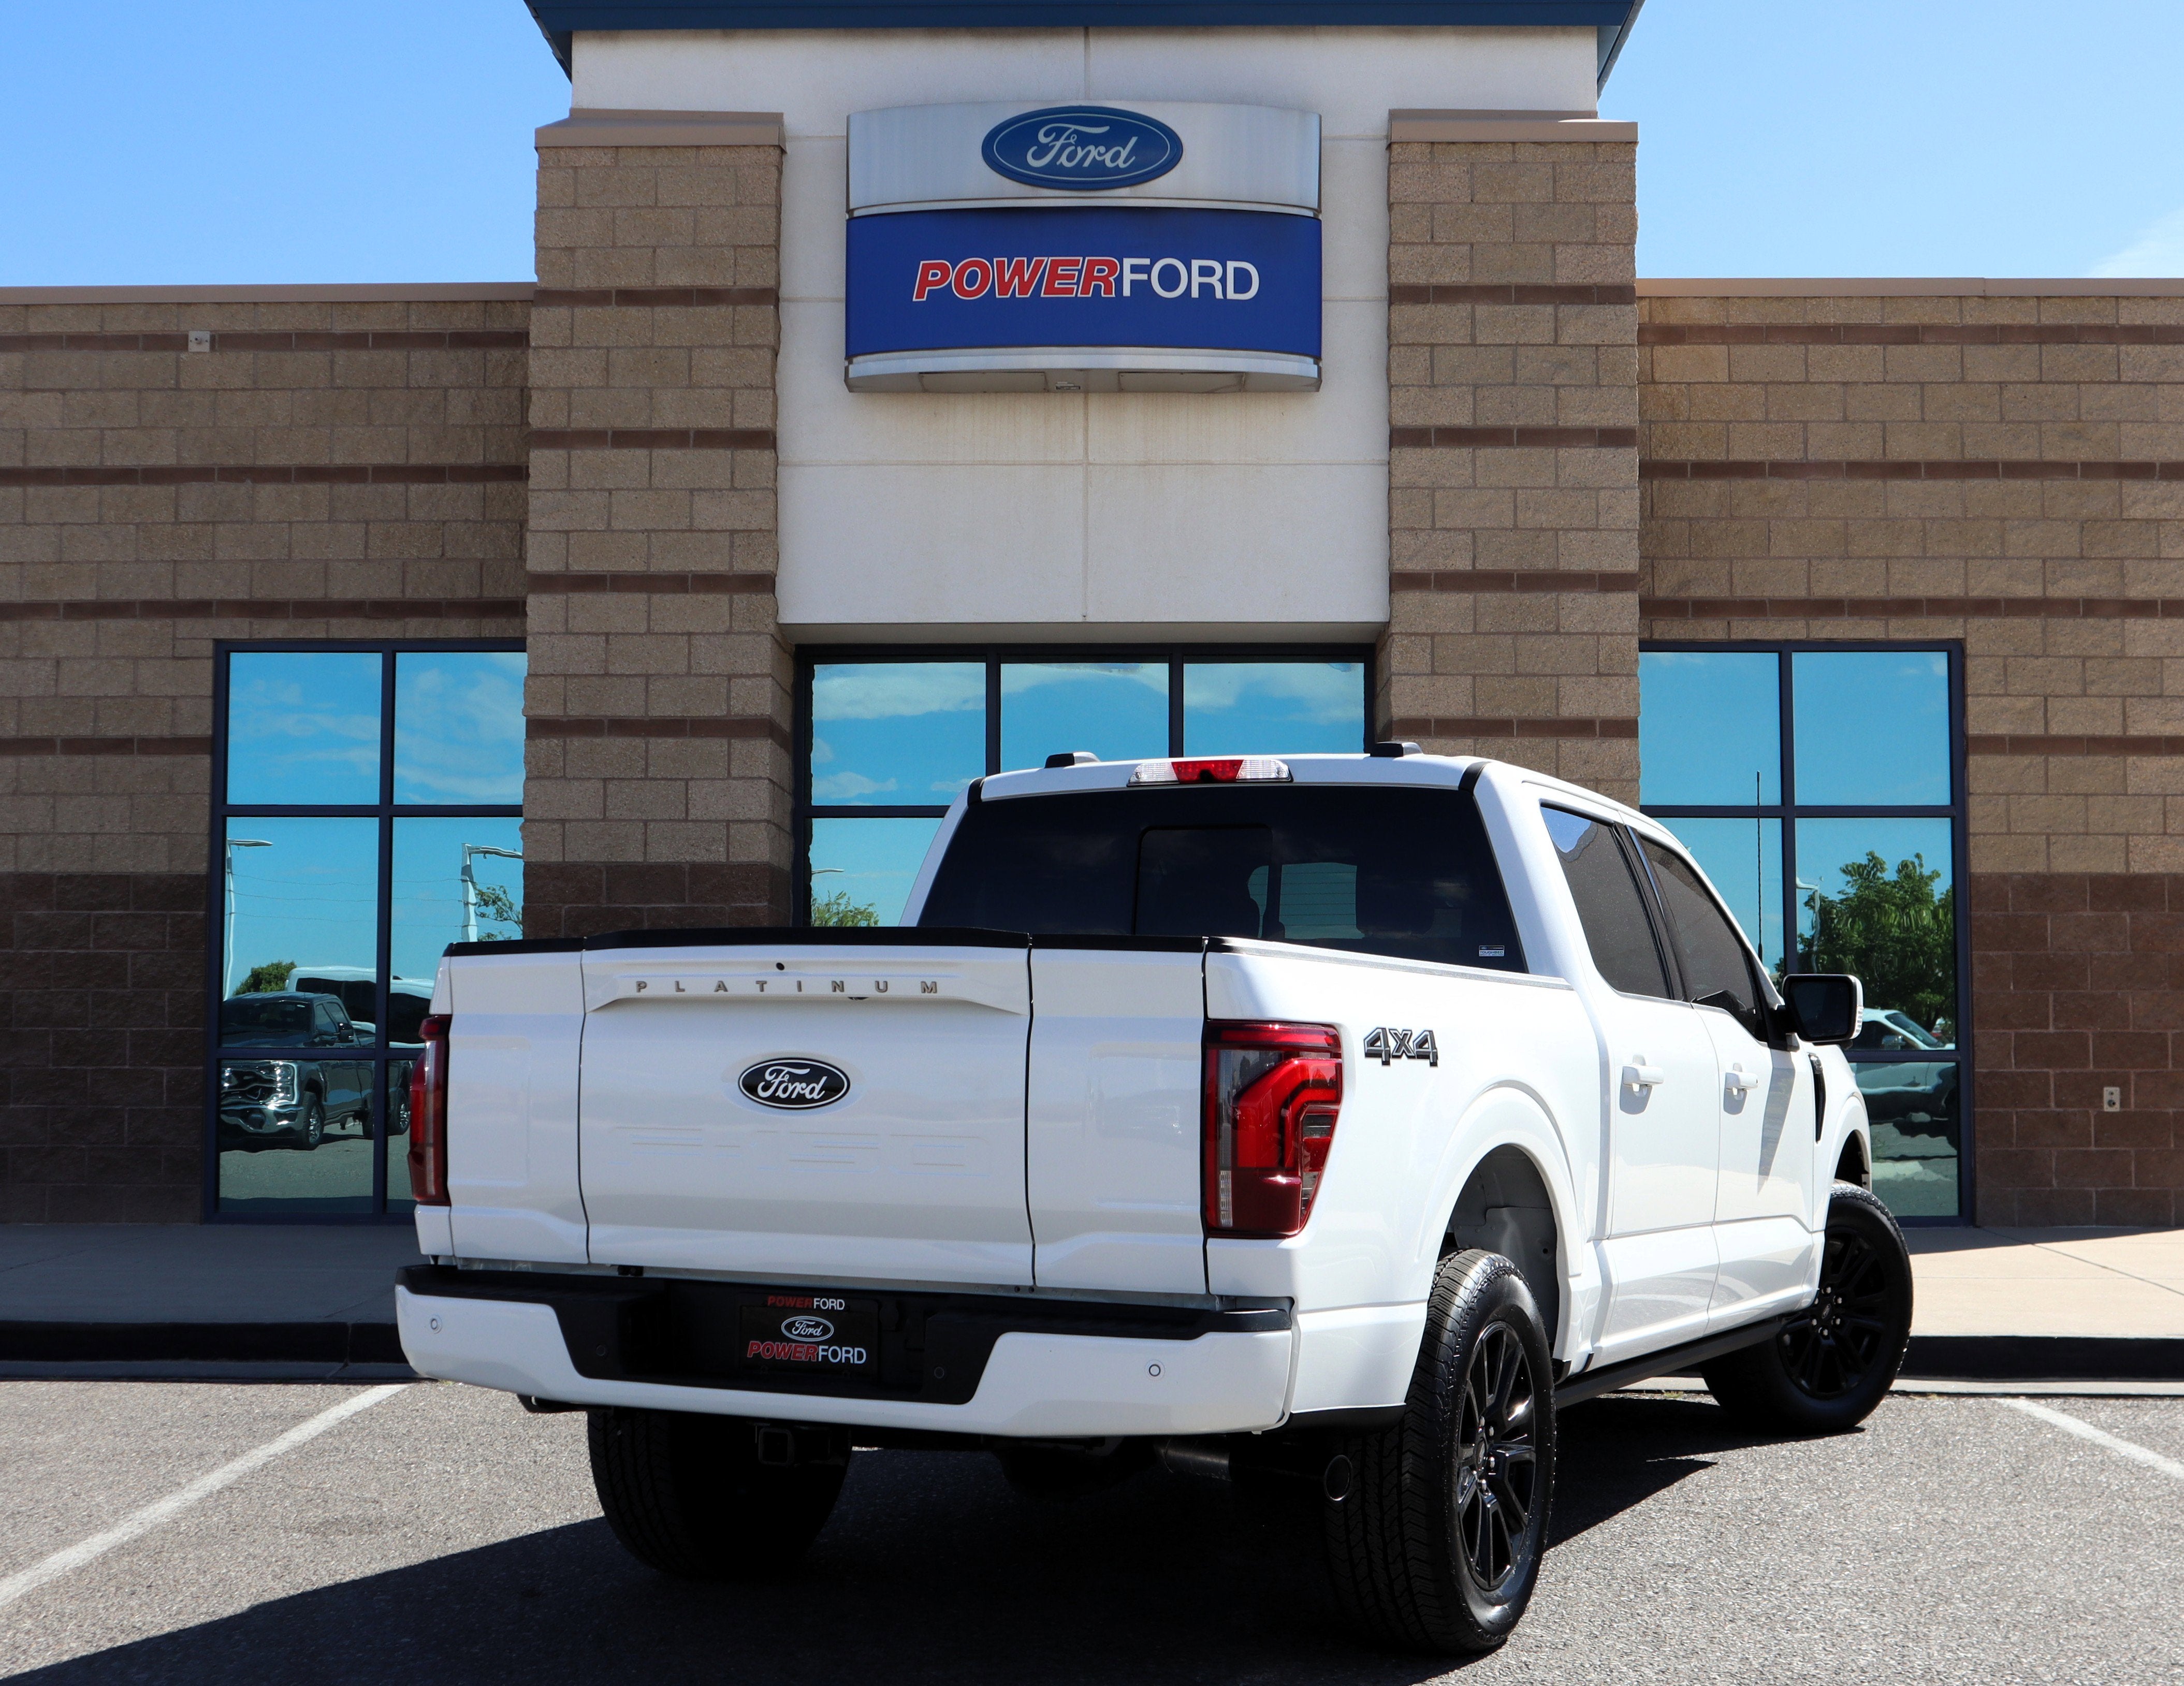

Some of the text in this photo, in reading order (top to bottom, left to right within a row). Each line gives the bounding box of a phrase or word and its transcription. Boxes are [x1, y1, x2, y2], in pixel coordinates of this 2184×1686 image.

[1026, 123, 1139, 168] Ford
[635, 980, 938, 994] PLATINUM
[756, 1066, 828, 1100] Ford
[791, 1320, 823, 1337] Ford
